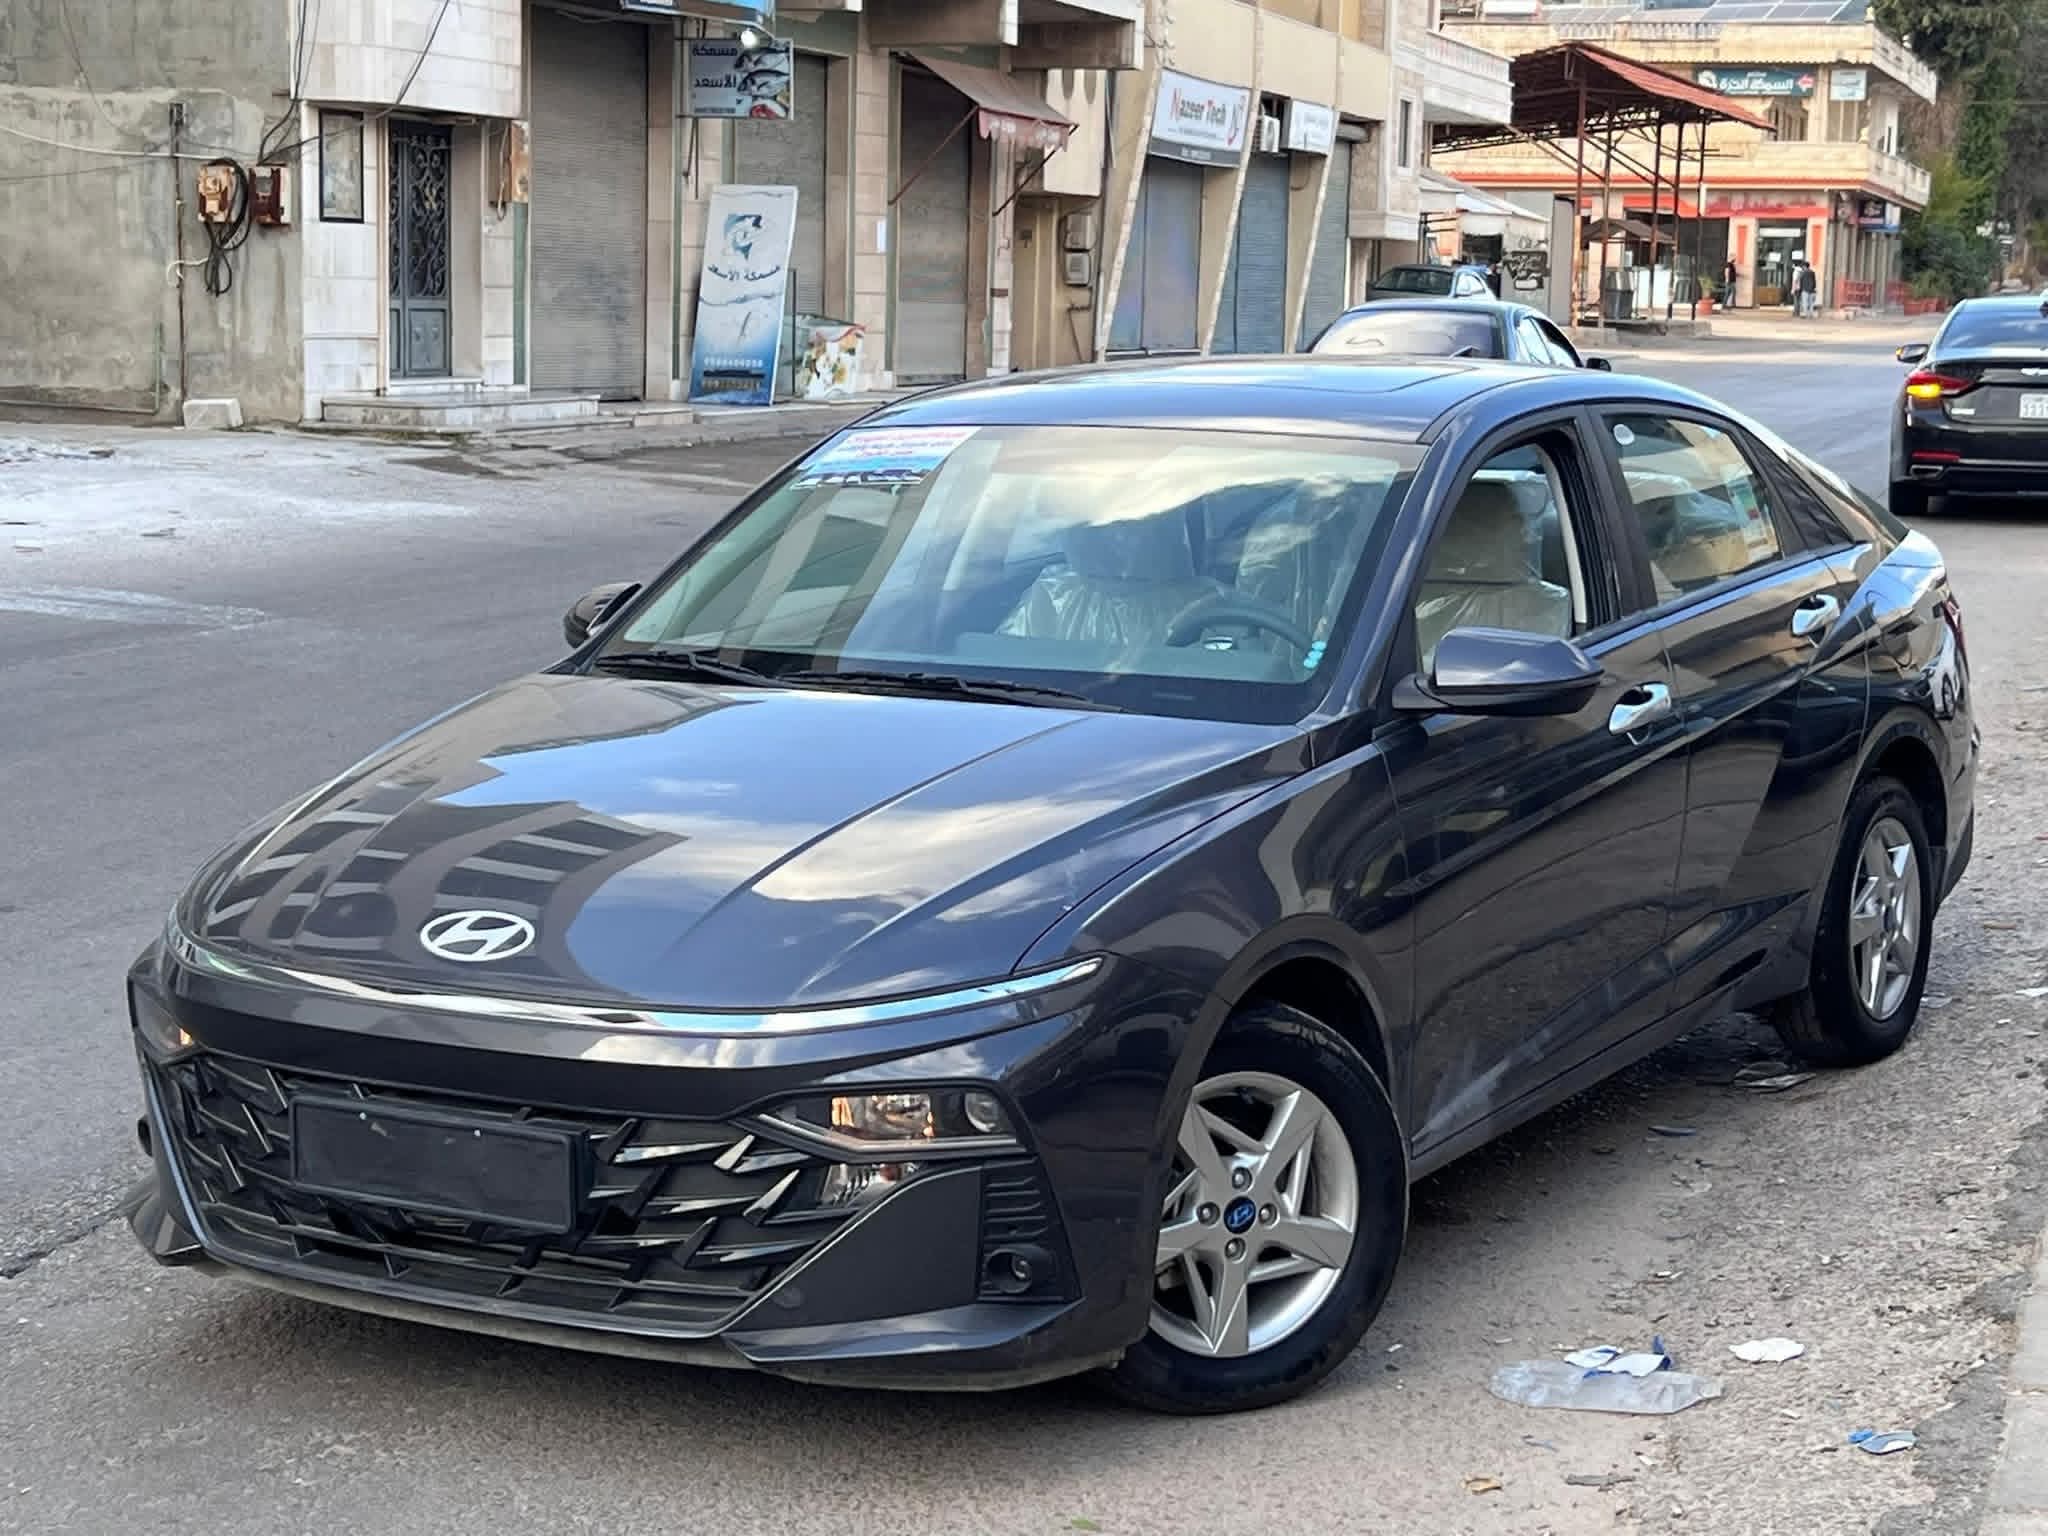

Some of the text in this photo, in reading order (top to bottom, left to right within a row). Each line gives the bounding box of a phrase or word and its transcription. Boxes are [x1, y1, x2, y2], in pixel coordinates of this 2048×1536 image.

[693, 44, 737, 56] مسمكة
[1170, 88, 1226, 124] Nazeer Tech
